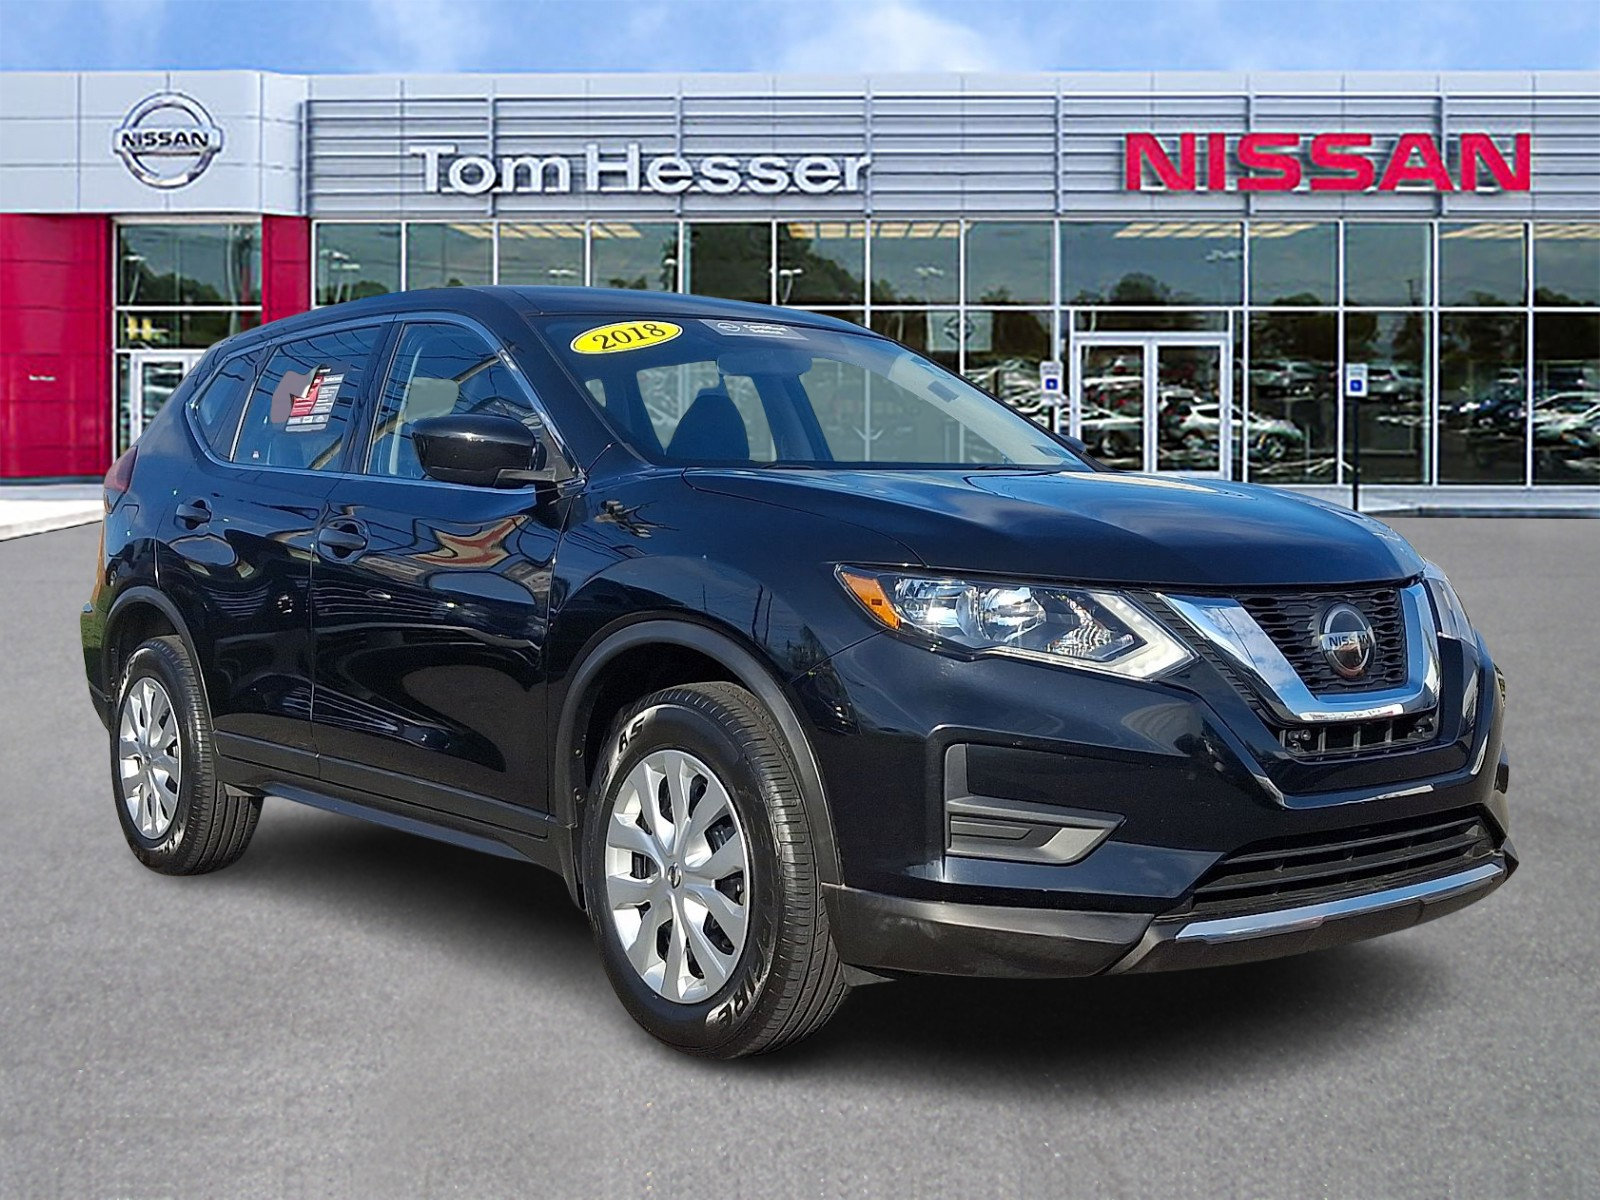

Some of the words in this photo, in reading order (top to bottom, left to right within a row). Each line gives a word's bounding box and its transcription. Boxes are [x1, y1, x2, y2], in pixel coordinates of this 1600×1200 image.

[122, 131, 209, 147] NISSAN
[409, 143, 571, 194] Tom
[585, 142, 871, 194] Hesser
[1125, 132, 1531, 191] NISSAN
[592, 323, 667, 350] 2018
